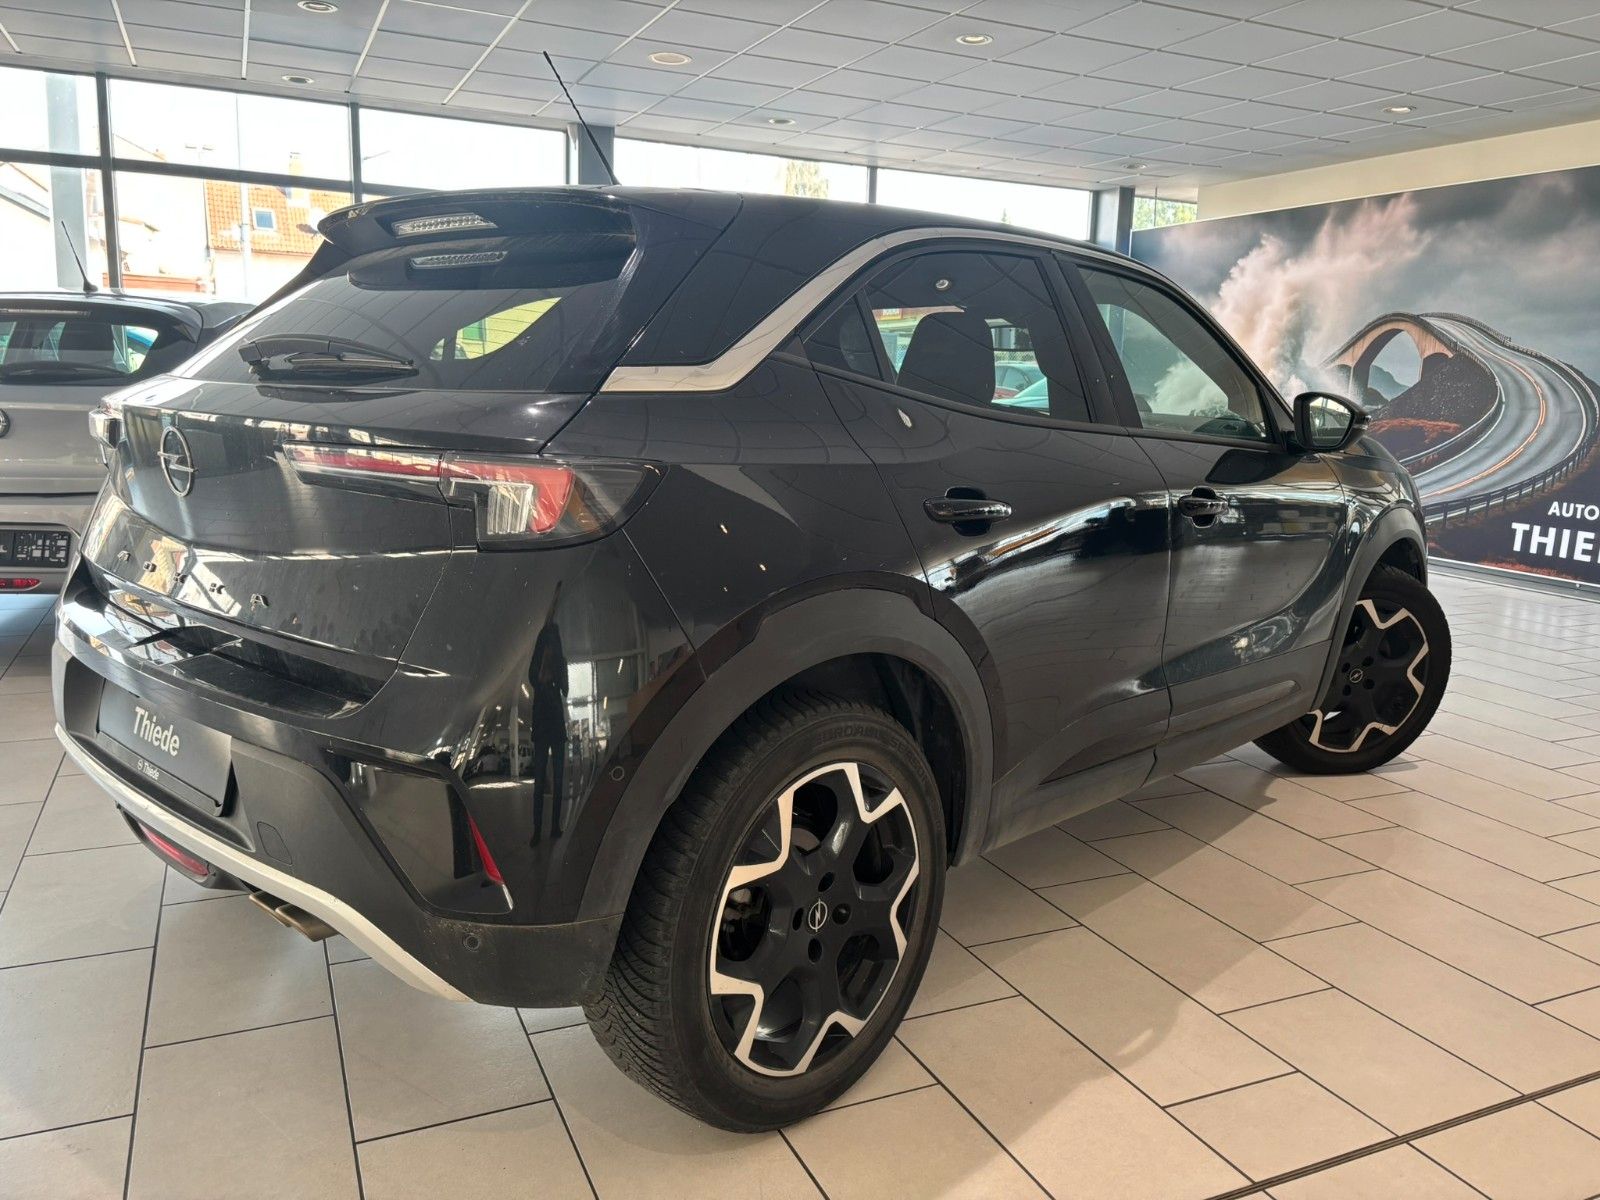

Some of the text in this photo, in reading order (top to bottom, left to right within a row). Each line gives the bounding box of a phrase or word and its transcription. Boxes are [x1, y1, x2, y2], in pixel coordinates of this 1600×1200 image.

[1547, 501, 1600, 521] AUTO
[1511, 522, 1600, 564] THIE
[133, 706, 180, 757] Thiede
